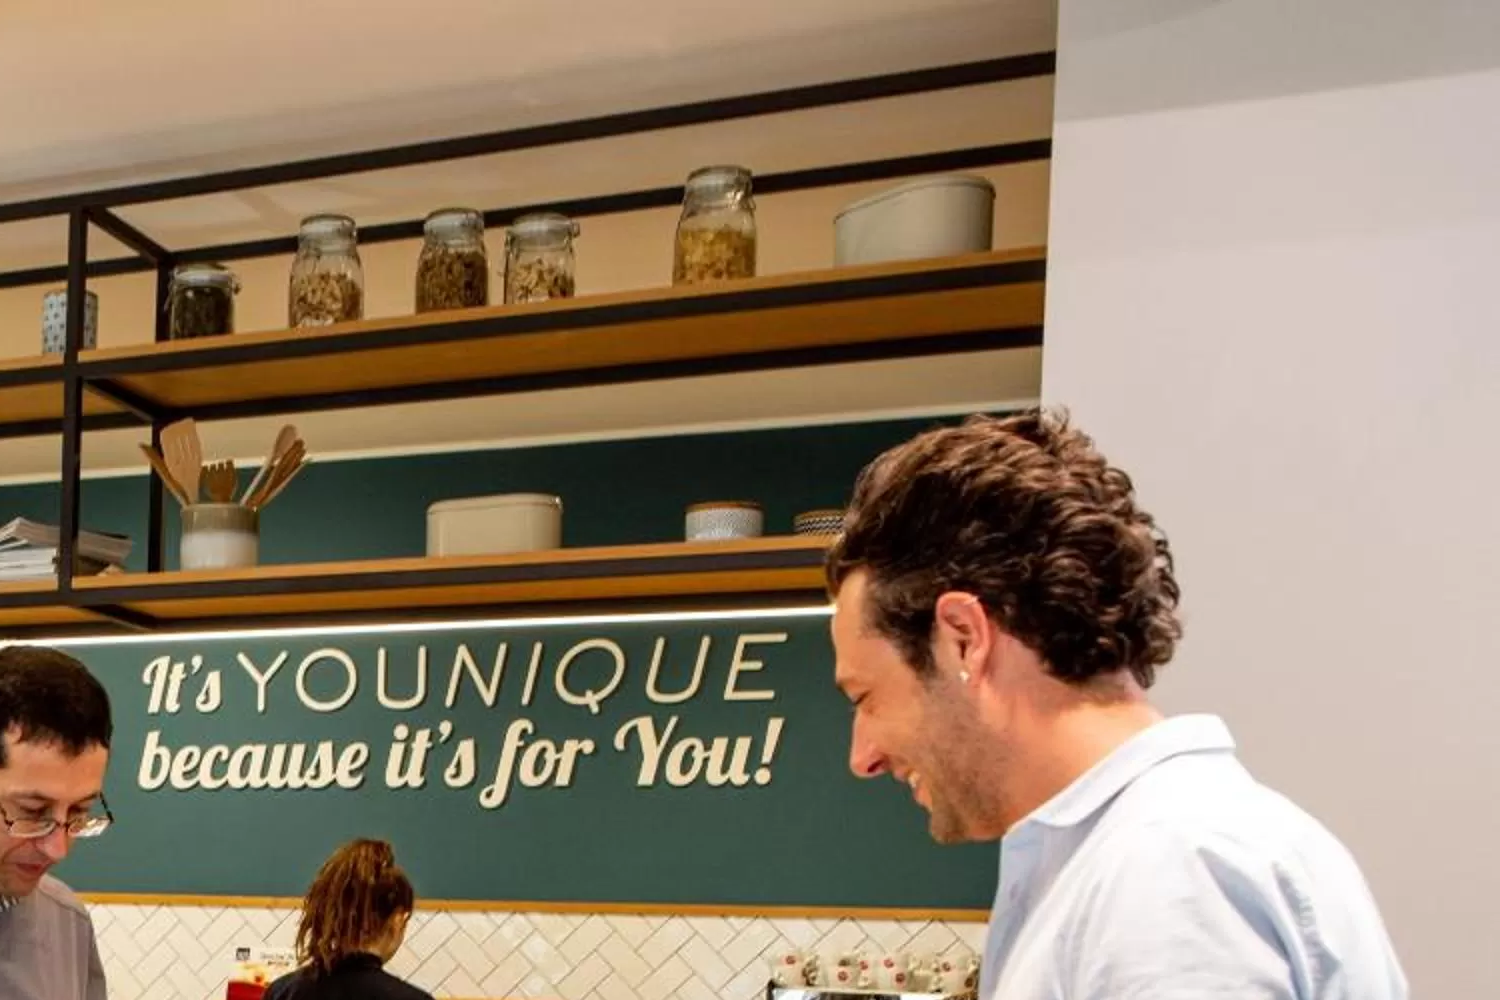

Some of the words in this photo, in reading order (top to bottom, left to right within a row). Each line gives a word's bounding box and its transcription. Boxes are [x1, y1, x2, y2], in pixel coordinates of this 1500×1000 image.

[140, 653, 222, 716] It's
[236, 632, 789, 716] YOUNIQUE
[136, 728, 371, 792] because
[384, 717, 478, 790] it's
[478, 716, 596, 811] for
[613, 714, 787, 788] You!
